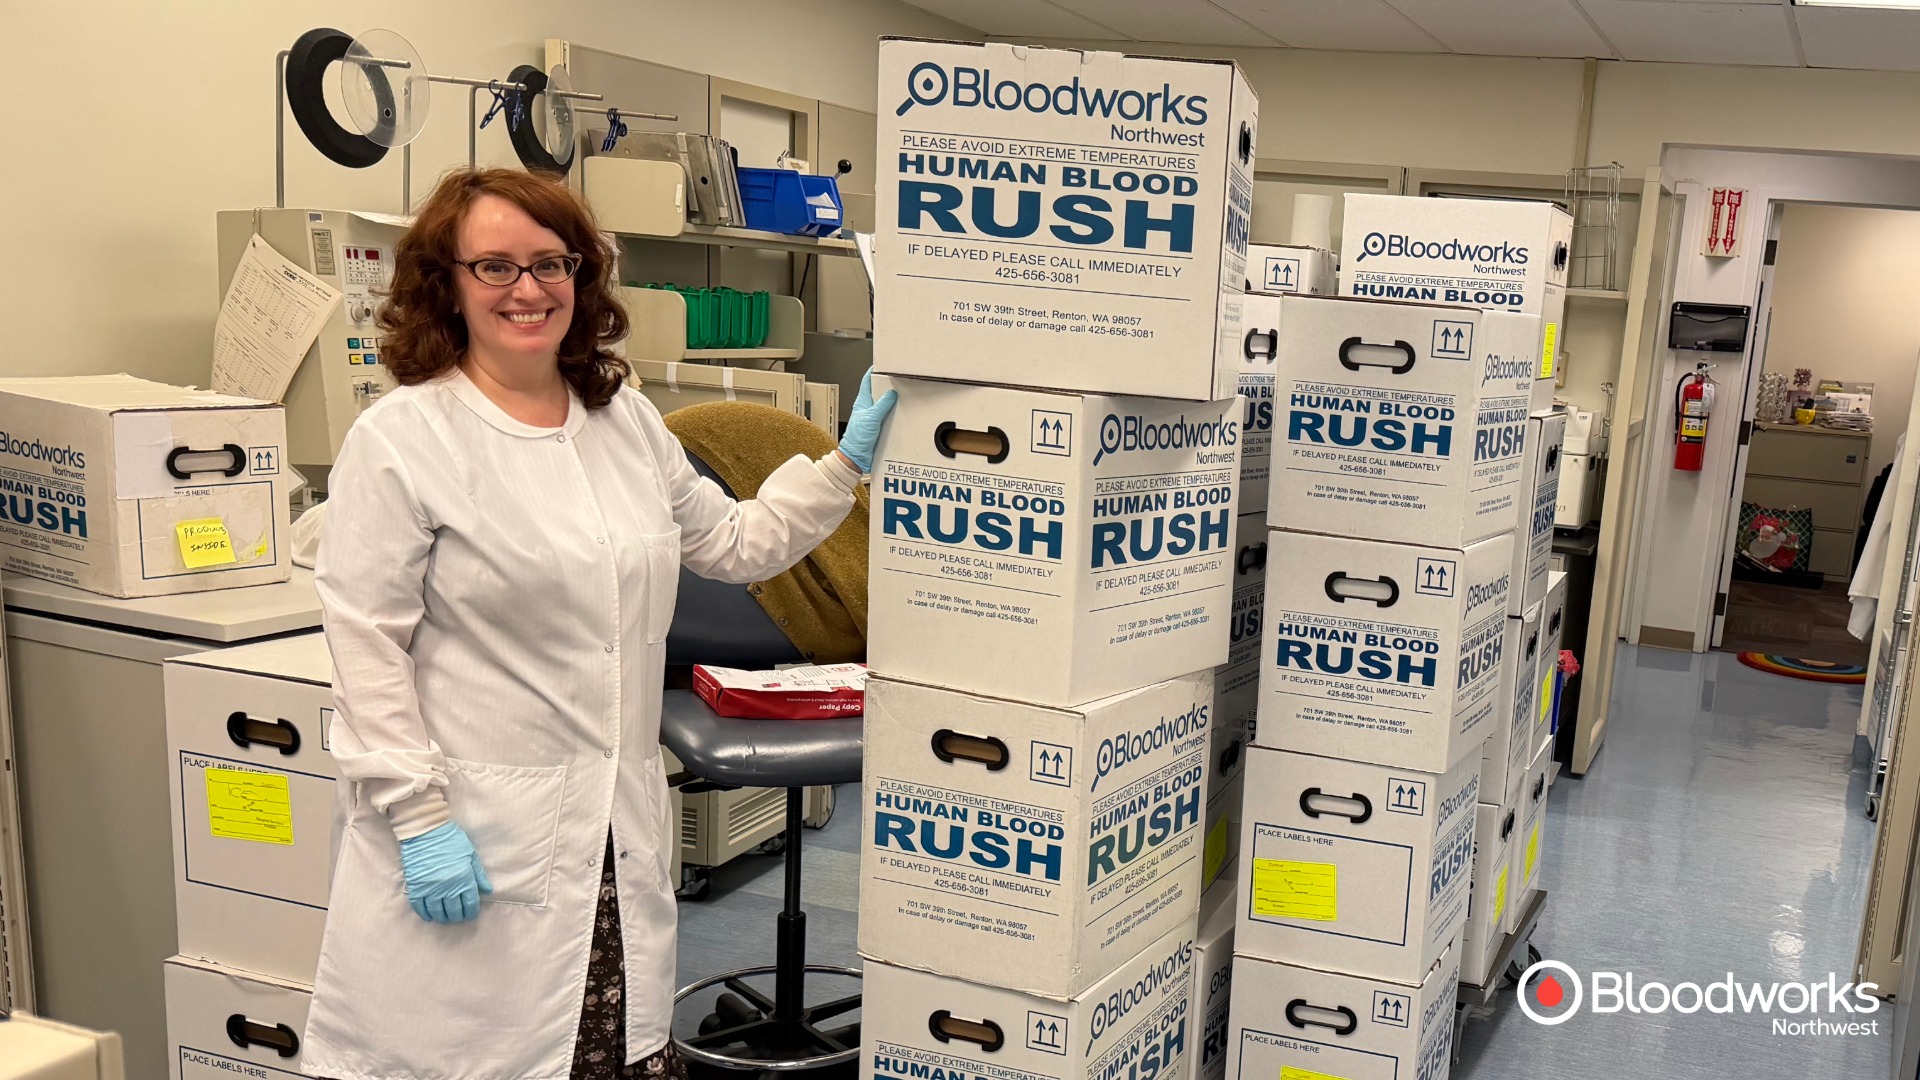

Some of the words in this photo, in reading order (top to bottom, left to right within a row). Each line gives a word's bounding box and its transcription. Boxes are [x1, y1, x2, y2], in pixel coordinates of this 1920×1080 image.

[952, 66, 1209, 126] Bloodworks
[1110, 124, 1204, 147] Northwest
[903, 135, 956, 150] PLEASE
[960, 140, 1004, 154] AVOID
[1009, 144, 1076, 160] EXTREME
[1080, 150, 1196, 170] TEMPERATURES
[898, 152, 1046, 185] HUMAN
[1061, 166, 1198, 198] BLOOD
[897, 179, 1194, 253] RUSH
[1226, 204, 1248, 256] RUSH
[908, 244, 919, 255] IF
[924, 245, 988, 261] DELAYED
[992, 251, 1046, 266] PLEASE
[1050, 256, 1084, 269] CALL
[1088, 259, 1181, 278] IMMEDIATELY
[1386, 234, 1528, 264] Bloodworks
[994, 267, 1079, 284] 425-656-3081
[1357, 272, 1387, 280] PLEASE
[1416, 276, 1453, 285] EXTREME
[1456, 279, 1521, 290] TEMPERATURES
[1473, 264, 1526, 276] Northwest
[1352, 282, 1436, 300] HUMAN
[1444, 289, 1523, 306] BLOOD
[939, 311, 947, 321] In
[950, 312, 973, 323] case
[976, 314, 986, 324] of
[988, 316, 1013, 329] delay
[1016, 318, 1026, 328] or
[1028, 319, 1067, 334] damage
[1069, 323, 1086, 333] call
[1087, 324, 1154, 339] 425-656-3081
[952, 300, 971, 311] 701
[973, 302, 991, 313] SW
[993, 304, 1014, 315] 39th
[1017, 306, 1049, 319] Street,
[1052, 309, 1088, 323] Renton,
[1091, 313, 1110, 323] WA
[1112, 315, 1141, 326] 98057
[1491, 355, 1533, 379] Bloodworks
[1290, 393, 1370, 413] HUMAN
[1378, 402, 1454, 422] BLOOD
[1295, 383, 1324, 392] PLEASE
[1326, 386, 1349, 394] AVOID
[1352, 388, 1388, 398] EXTREME
[1390, 392, 1454, 404] TEMPERATURES
[1123, 414, 1237, 451] Bloodworks
[1477, 410, 1504, 425] HUMAN
[1505, 408, 1527, 422] BLOOD
[1288, 410, 1452, 456] RUSH
[1474, 424, 1525, 462] RUSH
[52, 465, 85, 480] Northwest
[1196, 450, 1235, 465] Northwest
[1301, 450, 1336, 460] DELAYED
[1338, 454, 1367, 463] PLEASE
[1369, 457, 1388, 466] CALL
[1390, 459, 1442, 471] IMMEDIATELY
[1338, 464, 1385, 475] 425-656-3081
[887, 464, 919, 476] PLEASE
[921, 468, 947, 479] AVOID
[950, 472, 990, 485] EXTREME
[993, 478, 1064, 495] TEMPERATURES
[1096, 480, 1124, 492] PLEASE
[1126, 479, 1147, 490] AVOID
[1149, 476, 1180, 488] EXTREME
[1182, 472, 1230, 485] TEMPERATURES
[38, 486, 85, 508] BLOOD
[883, 477, 971, 504] HUMAN
[980, 490, 1064, 517] BLOOD
[1092, 492, 1166, 518] HUMAN
[1173, 486, 1231, 509] BLOOD
[883, 497, 1062, 560] RUSH
[1532, 502, 1555, 538] RUSH
[1091, 508, 1229, 569] RUSH
[889, 545, 895, 554] IF
[898, 546, 936, 560] DELAYED
[939, 553, 971, 566] PLEASE
[973, 558, 994, 569] CALL
[997, 561, 1054, 578] IMMEDIATELY
[940, 565, 991, 580] 425-656-3081
[1278, 622, 1356, 644] HUMAN
[1364, 633, 1439, 654] BLOOD
[1282, 613, 1311, 622] PLEASE
[1312, 616, 1336, 625] AVOID
[1338, 620, 1374, 630] EXTREME
[1376, 624, 1439, 638] TEMPERATURES
[1276, 638, 1436, 686] RUSH
[1457, 633, 1502, 690] RUSH
[1290, 675, 1324, 686] DELAYED
[1326, 680, 1354, 690] PLEASE
[1356, 684, 1375, 693] CALL
[1376, 687, 1427, 700] IMMEDIATELY
[1326, 689, 1372, 701] 425-656-3081
[1114, 704, 1207, 769] Bloodworks
[875, 791, 967, 823] HUMAN
[977, 810, 1064, 841] BLOOD
[880, 779, 913, 793] PLEASE
[915, 786, 942, 798] AVOID
[945, 792, 987, 807] EXTREME
[990, 800, 1063, 821] TEMPERATURES
[1089, 792, 1148, 839] HUMAN
[1153, 764, 1201, 804] BLOOD
[874, 810, 1061, 881] RUSH
[1086, 784, 1199, 886] RUSH
[1259, 828, 1281, 837] PLACE
[1284, 833, 1311, 842] LABELS
[1313, 838, 1333, 846] HERE
[880, 856, 887, 865] IF
[890, 858, 930, 873] DELAYED
[932, 866, 966, 880] PLEASE
[968, 874, 990, 885] CALL
[993, 878, 1053, 898] IMMEDIATELY
[1430, 831, 1472, 902] RUSH
[934, 878, 987, 896] 425-656-3081
[1107, 940, 1192, 1029] Bloodworks
[1161, 963, 1190, 998] Northwest
[1144, 996, 1187, 1049] BLOOD
[878, 1044, 912, 1058] PLEASE
[914, 1052, 941, 1064] AVOID
[943, 1058, 984, 1072] EXTREME
[1246, 1034, 1268, 1044] PLACE
[1271, 1039, 1298, 1049] LABELS
[1300, 1045, 1320, 1053] HERE
[184, 1053, 209, 1065] PLACE
[212, 1059, 242, 1073] LABELS
[244, 1067, 267, 1078] HERE
